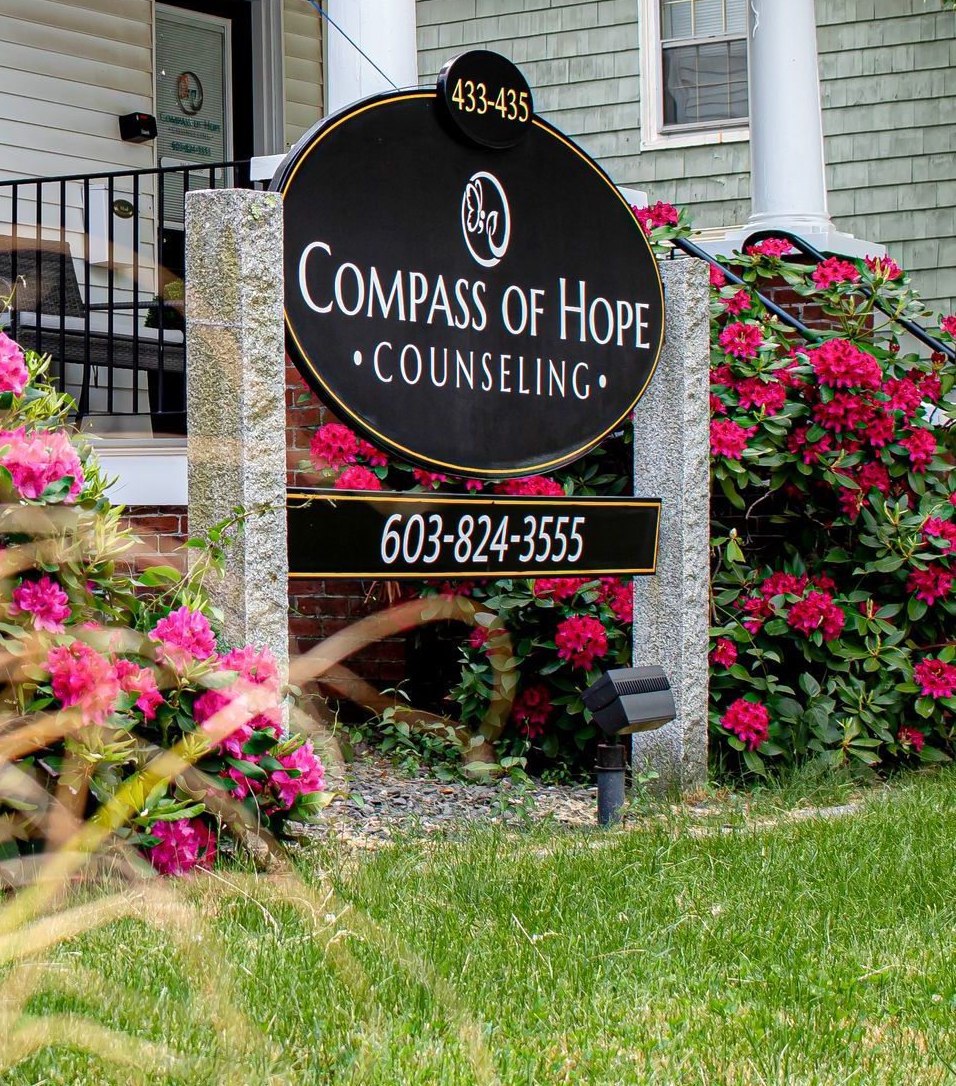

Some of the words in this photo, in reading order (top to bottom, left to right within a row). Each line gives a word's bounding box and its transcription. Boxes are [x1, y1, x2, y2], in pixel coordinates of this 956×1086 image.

[451, 78, 529, 123] 433-435
[298, 241, 487, 332] COMPASS
[502, 284, 546, 337] OF
[559, 277, 650, 349] HOPE
[373, 341, 590, 400] COUNSELING
[380, 513, 586, 564] 603-824-3555
